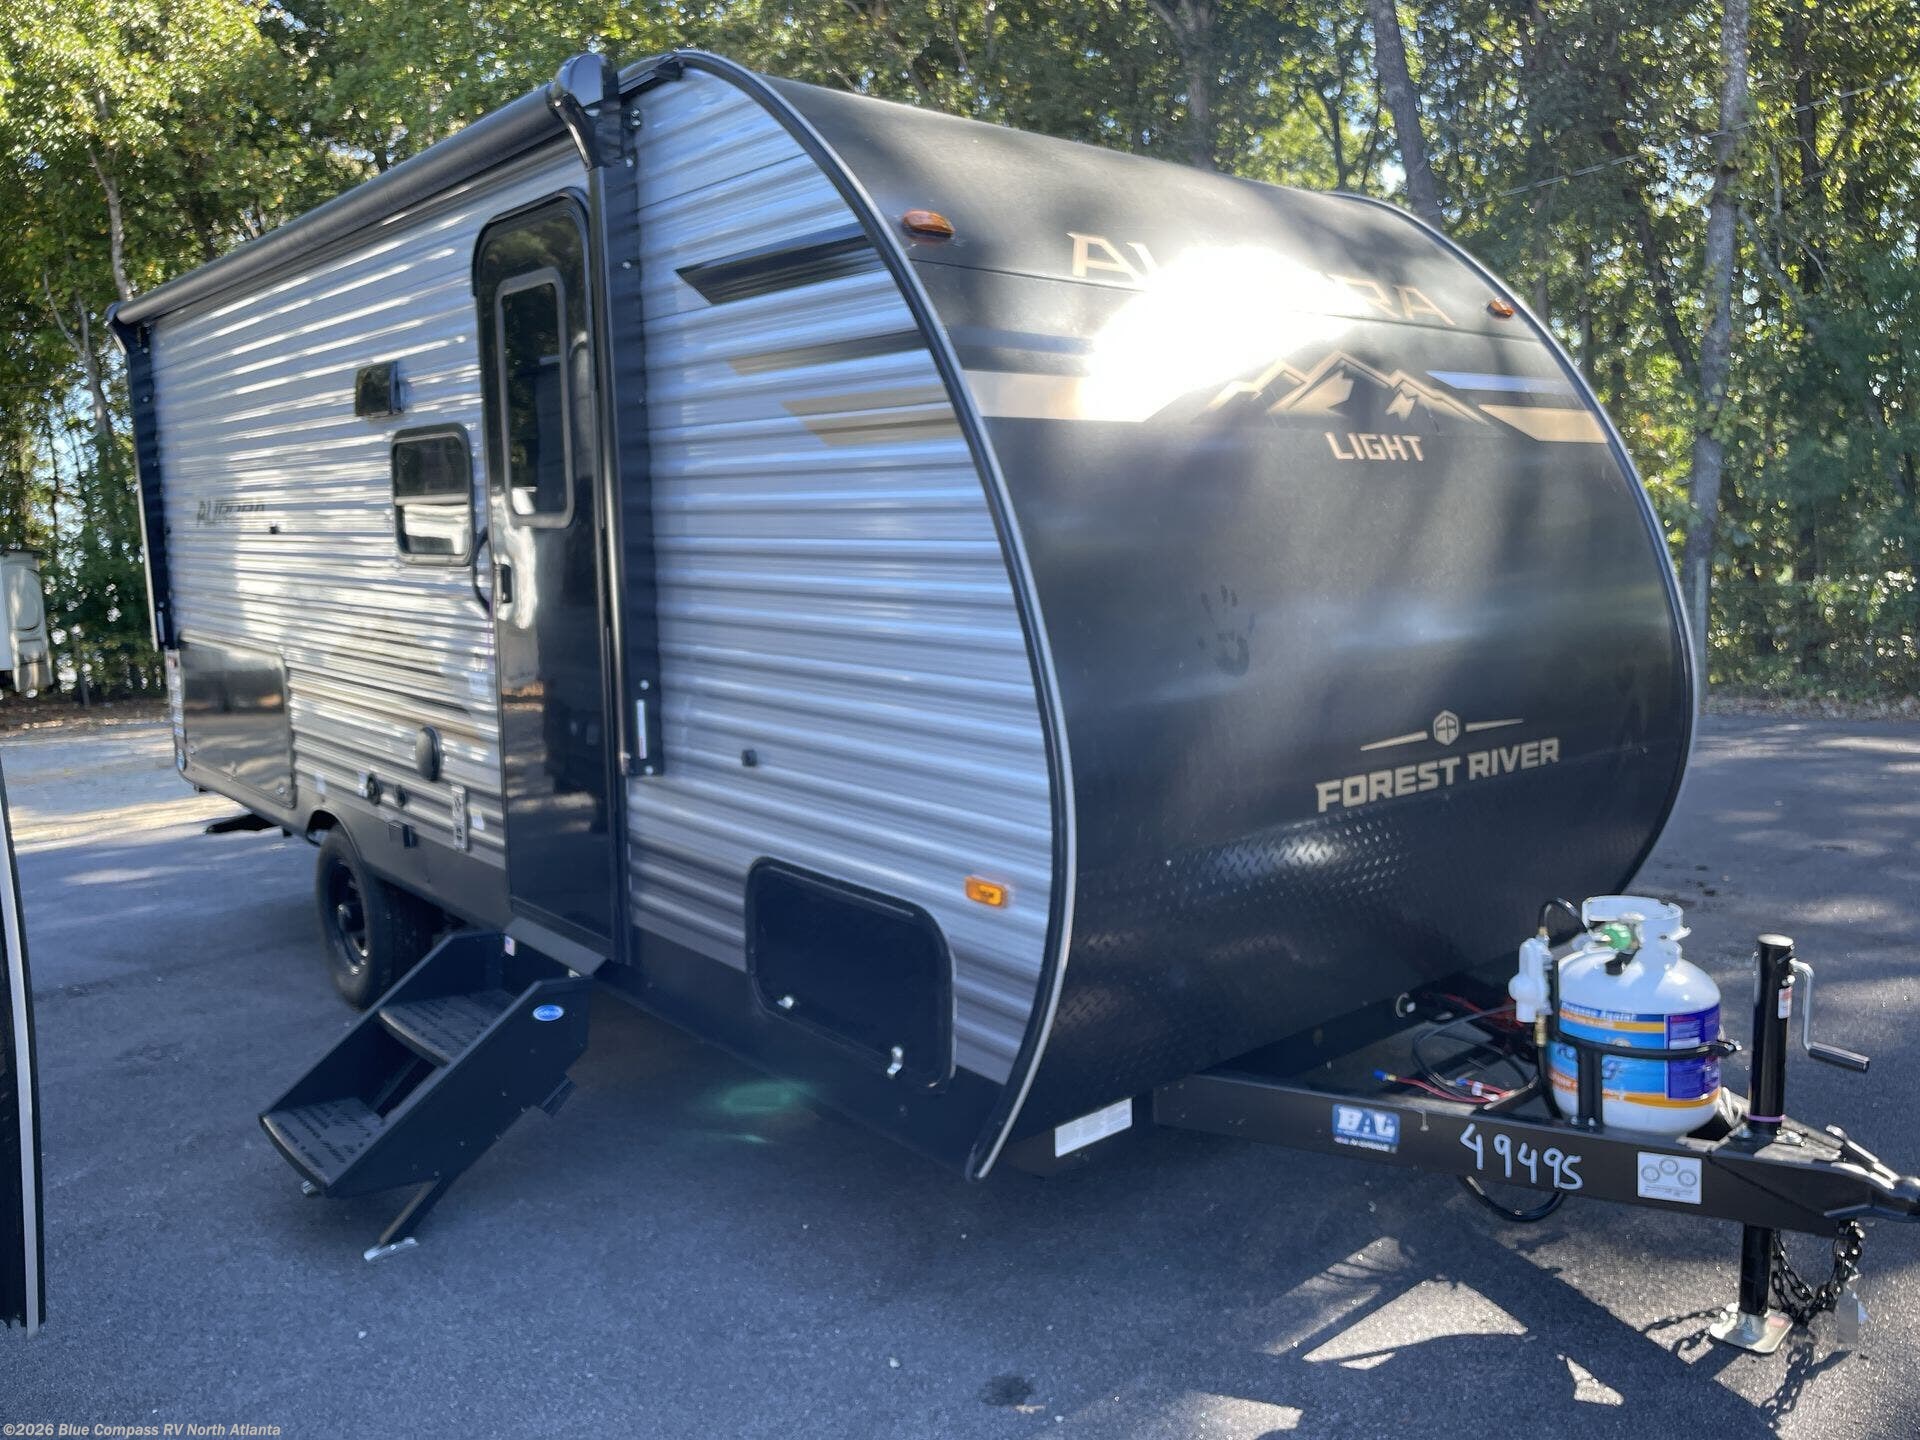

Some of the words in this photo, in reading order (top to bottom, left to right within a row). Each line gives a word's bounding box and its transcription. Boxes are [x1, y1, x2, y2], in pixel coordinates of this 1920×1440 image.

[1324, 431, 1424, 462] LIGHT
[1315, 756, 1461, 813] FOREST
[1467, 737, 1560, 781] RIVER
[1460, 1122, 1583, 1190] 49495
